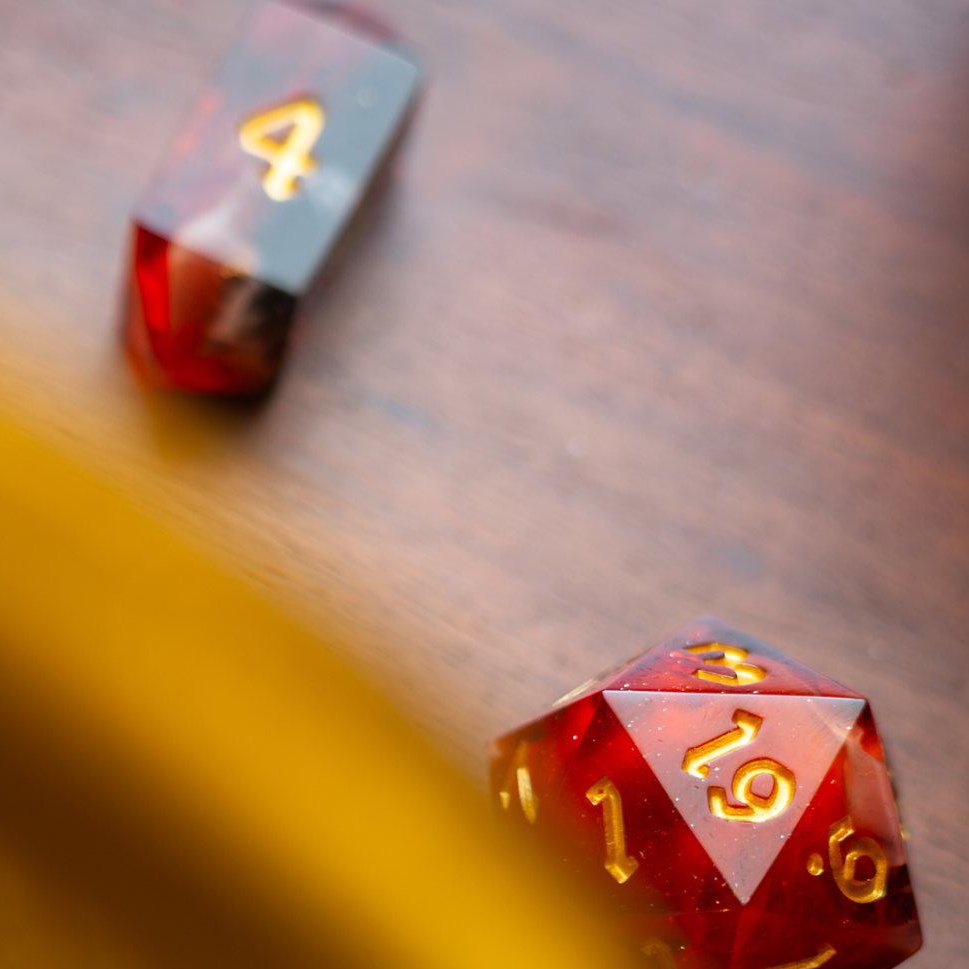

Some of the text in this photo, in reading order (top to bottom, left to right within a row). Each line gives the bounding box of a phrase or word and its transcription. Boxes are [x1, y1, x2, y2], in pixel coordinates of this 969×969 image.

[236, 96, 328, 203] 4
[683, 642, 769, 687] 3
[681, 708, 797, 824] 19
[585, 775, 639, 884] 1
